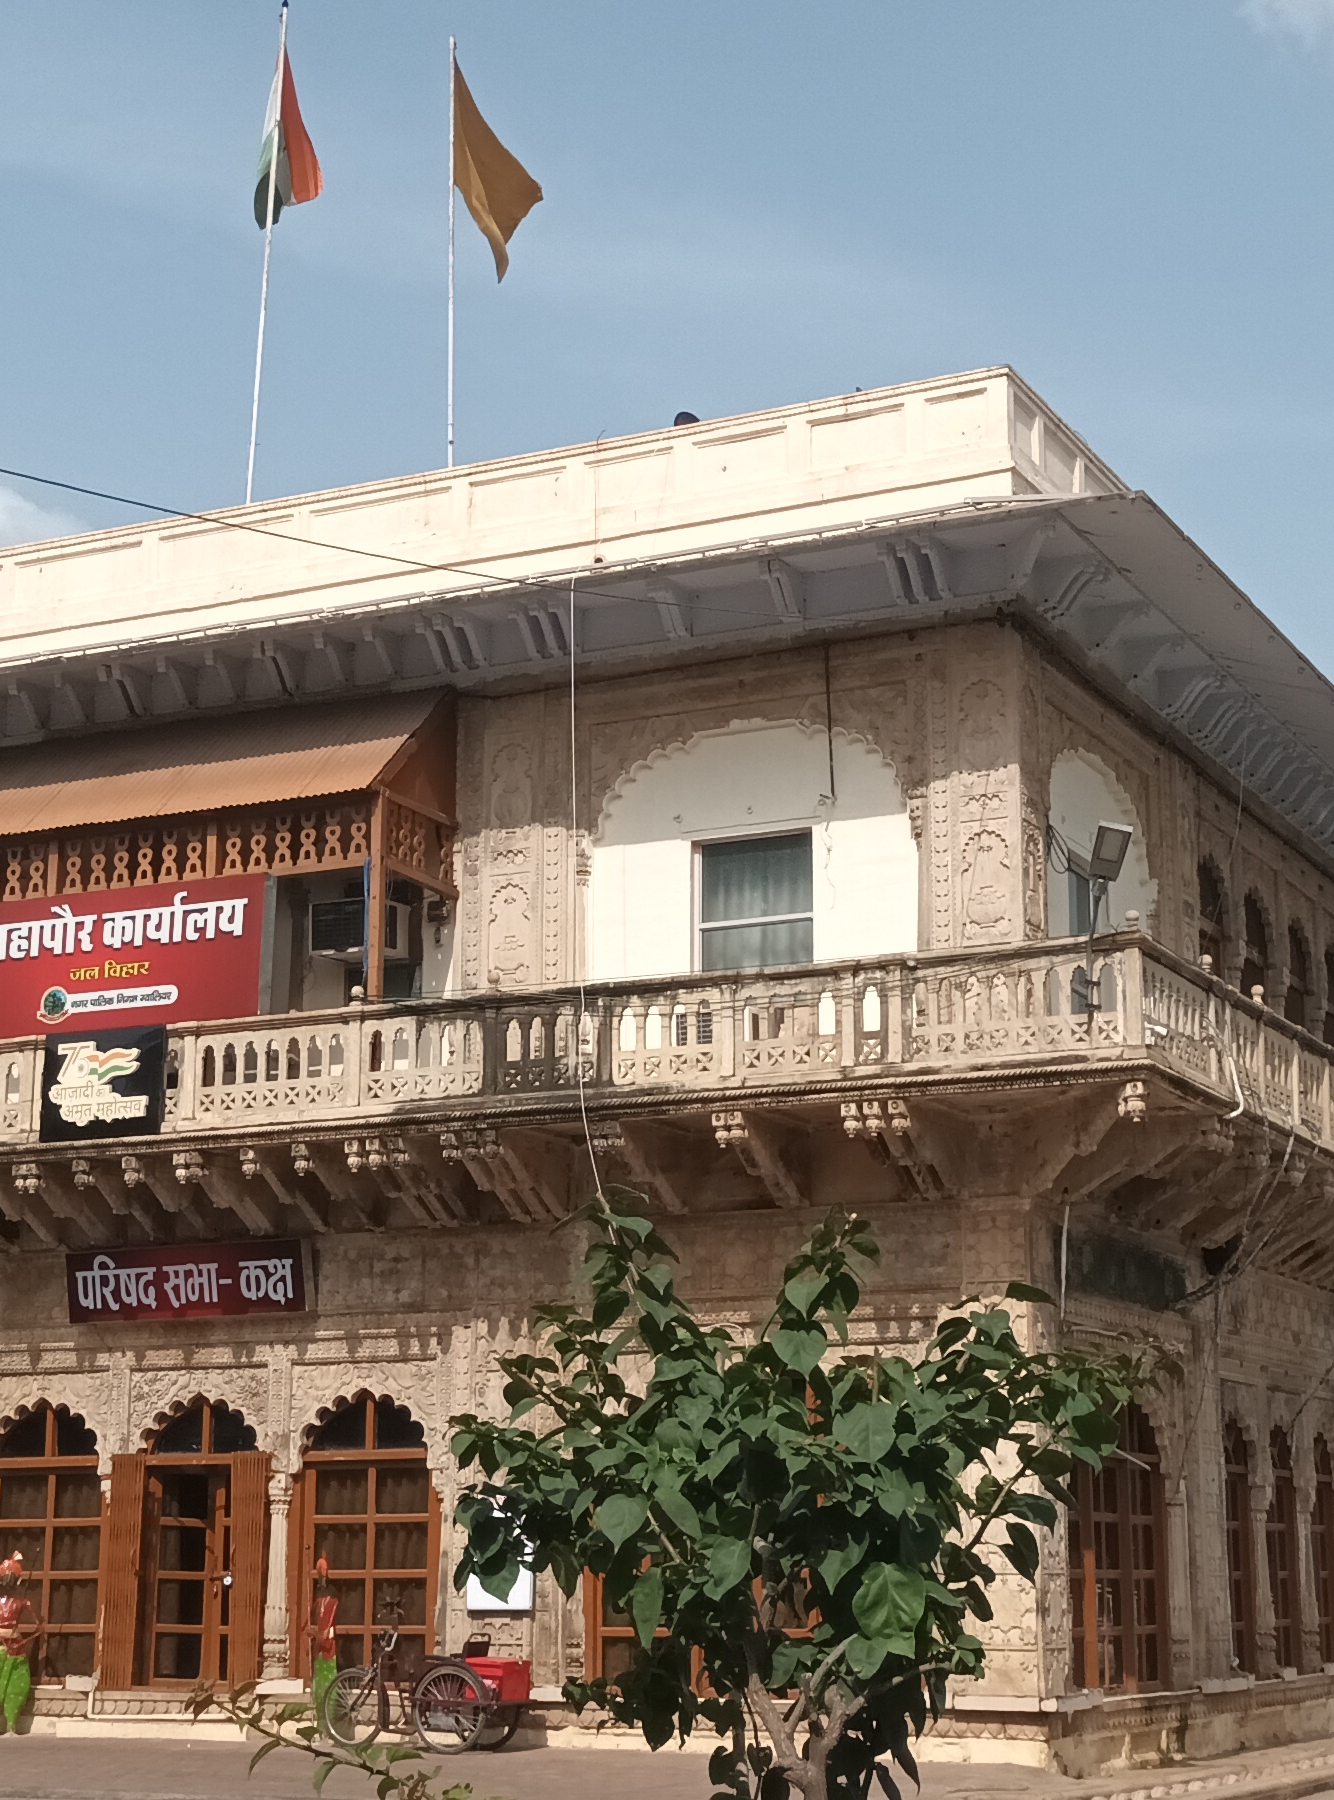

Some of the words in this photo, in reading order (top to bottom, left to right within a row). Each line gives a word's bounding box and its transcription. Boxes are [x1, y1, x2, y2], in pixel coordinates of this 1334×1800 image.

[102, 891, 249, 949] कार्यालय
[69, 966, 100, 981] जल
[104, 959, 151, 978] विहार
[64, 1104, 93, 1123] अमृत
[97, 1096, 143, 1117] महोत्सव
[75, 1255, 158, 1311] परिषद
[238, 1258, 294, 1306] कक्ष
